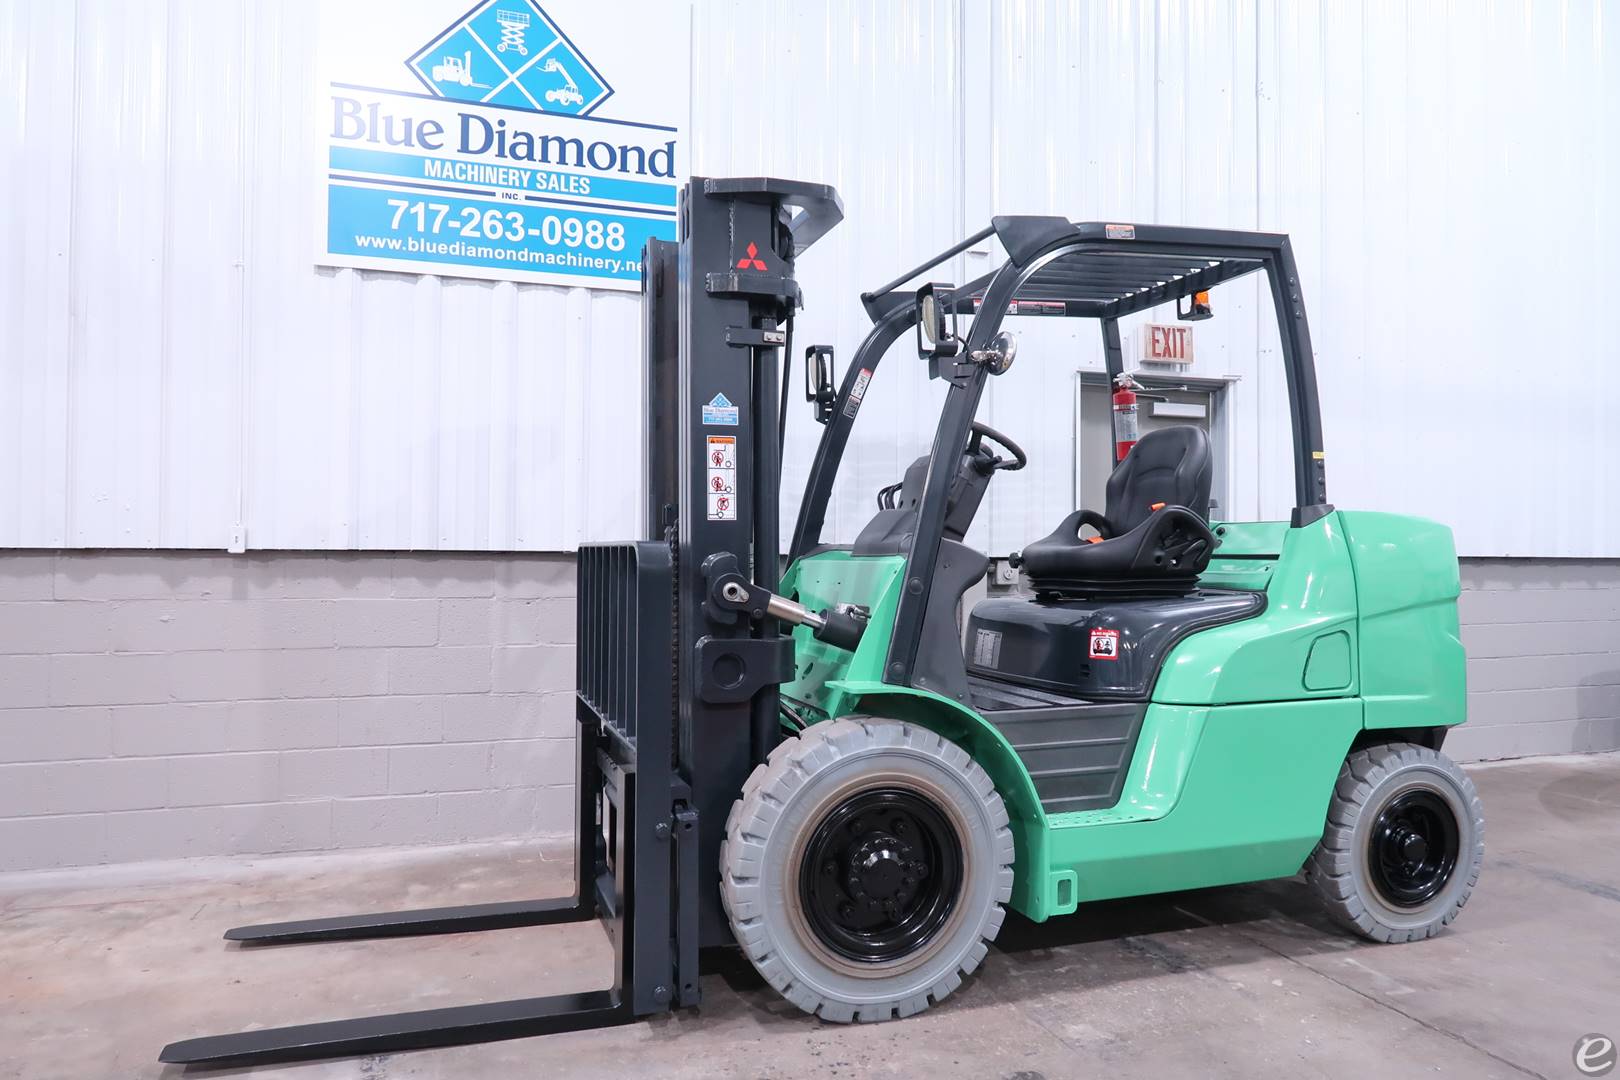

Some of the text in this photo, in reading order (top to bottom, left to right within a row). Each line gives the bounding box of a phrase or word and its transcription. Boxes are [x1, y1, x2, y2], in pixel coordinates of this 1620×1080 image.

[330, 96, 676, 178] Blue Diamond
[424, 159, 591, 195] MACHINERY SALES
[501, 192, 522, 201] INC.
[387, 199, 625, 251] 717-263-0988
[1151, 326, 1186, 359] EXIT
